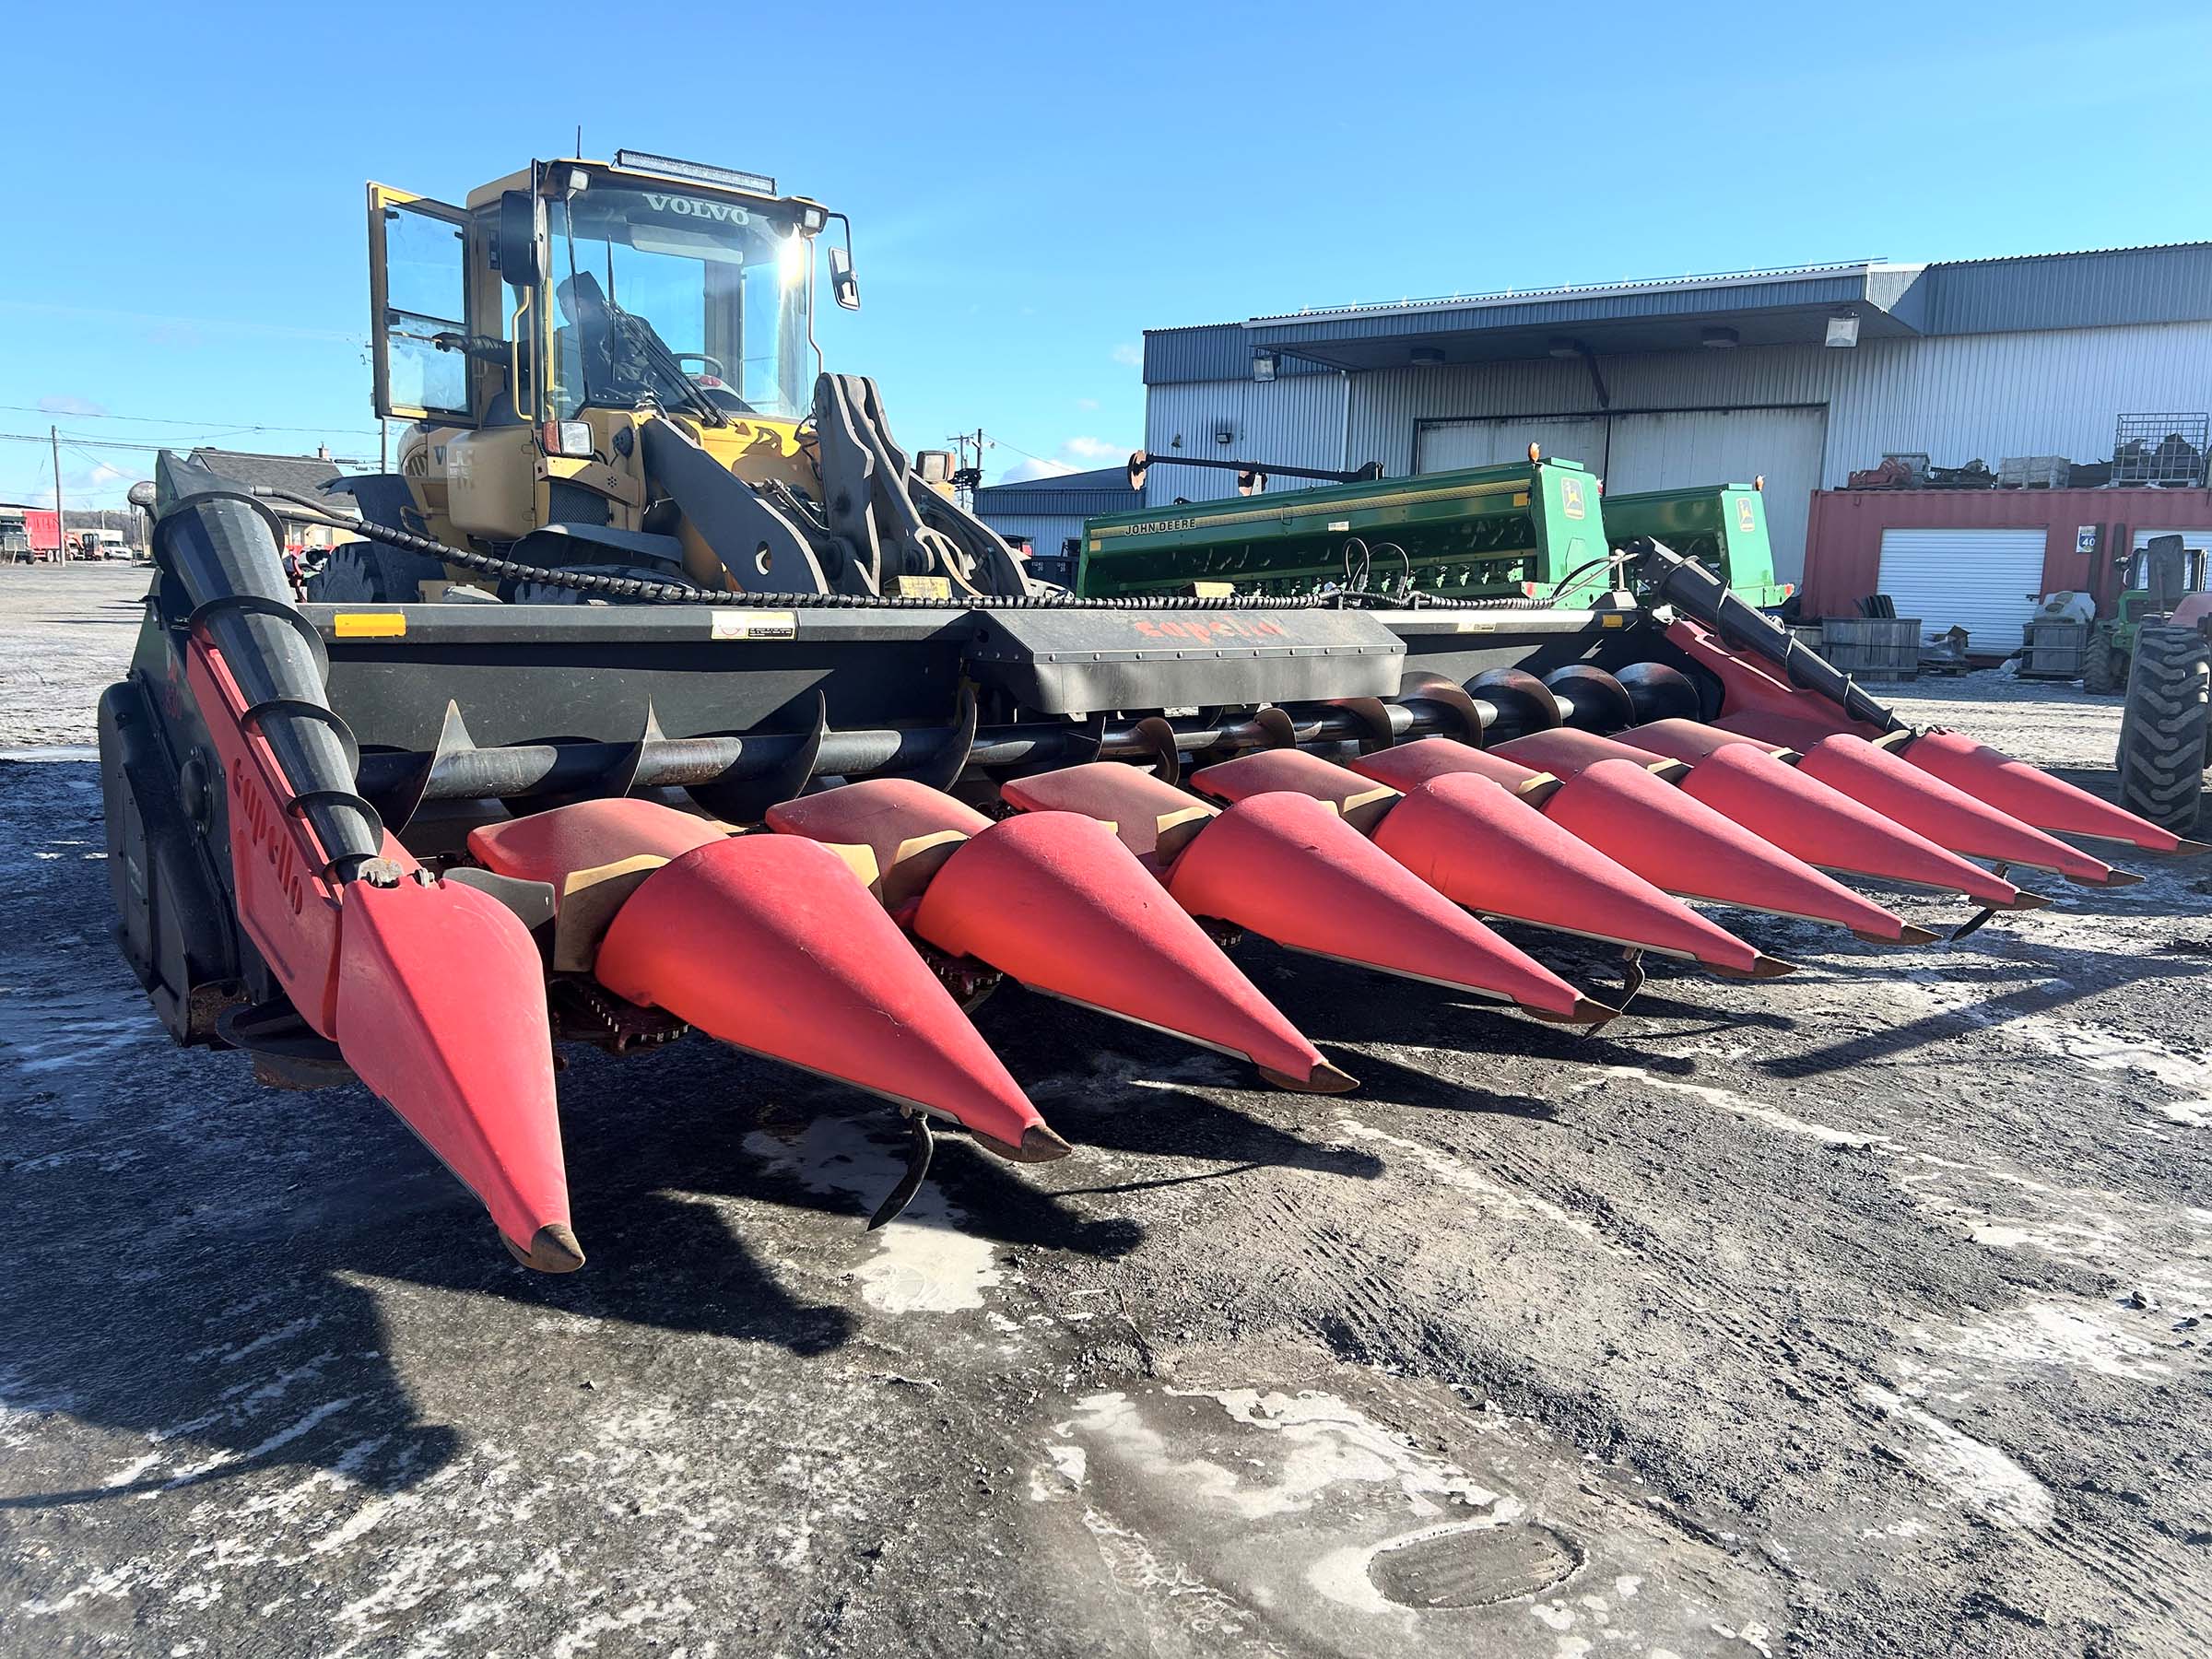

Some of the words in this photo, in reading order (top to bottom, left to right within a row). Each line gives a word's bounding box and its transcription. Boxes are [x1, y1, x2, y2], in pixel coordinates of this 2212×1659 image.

[642, 193, 749, 226] VOLVO
[1124, 523, 1157, 535] JOHN
[1159, 518, 1196, 532] DEERE
[2082, 537, 2096, 547] 40
